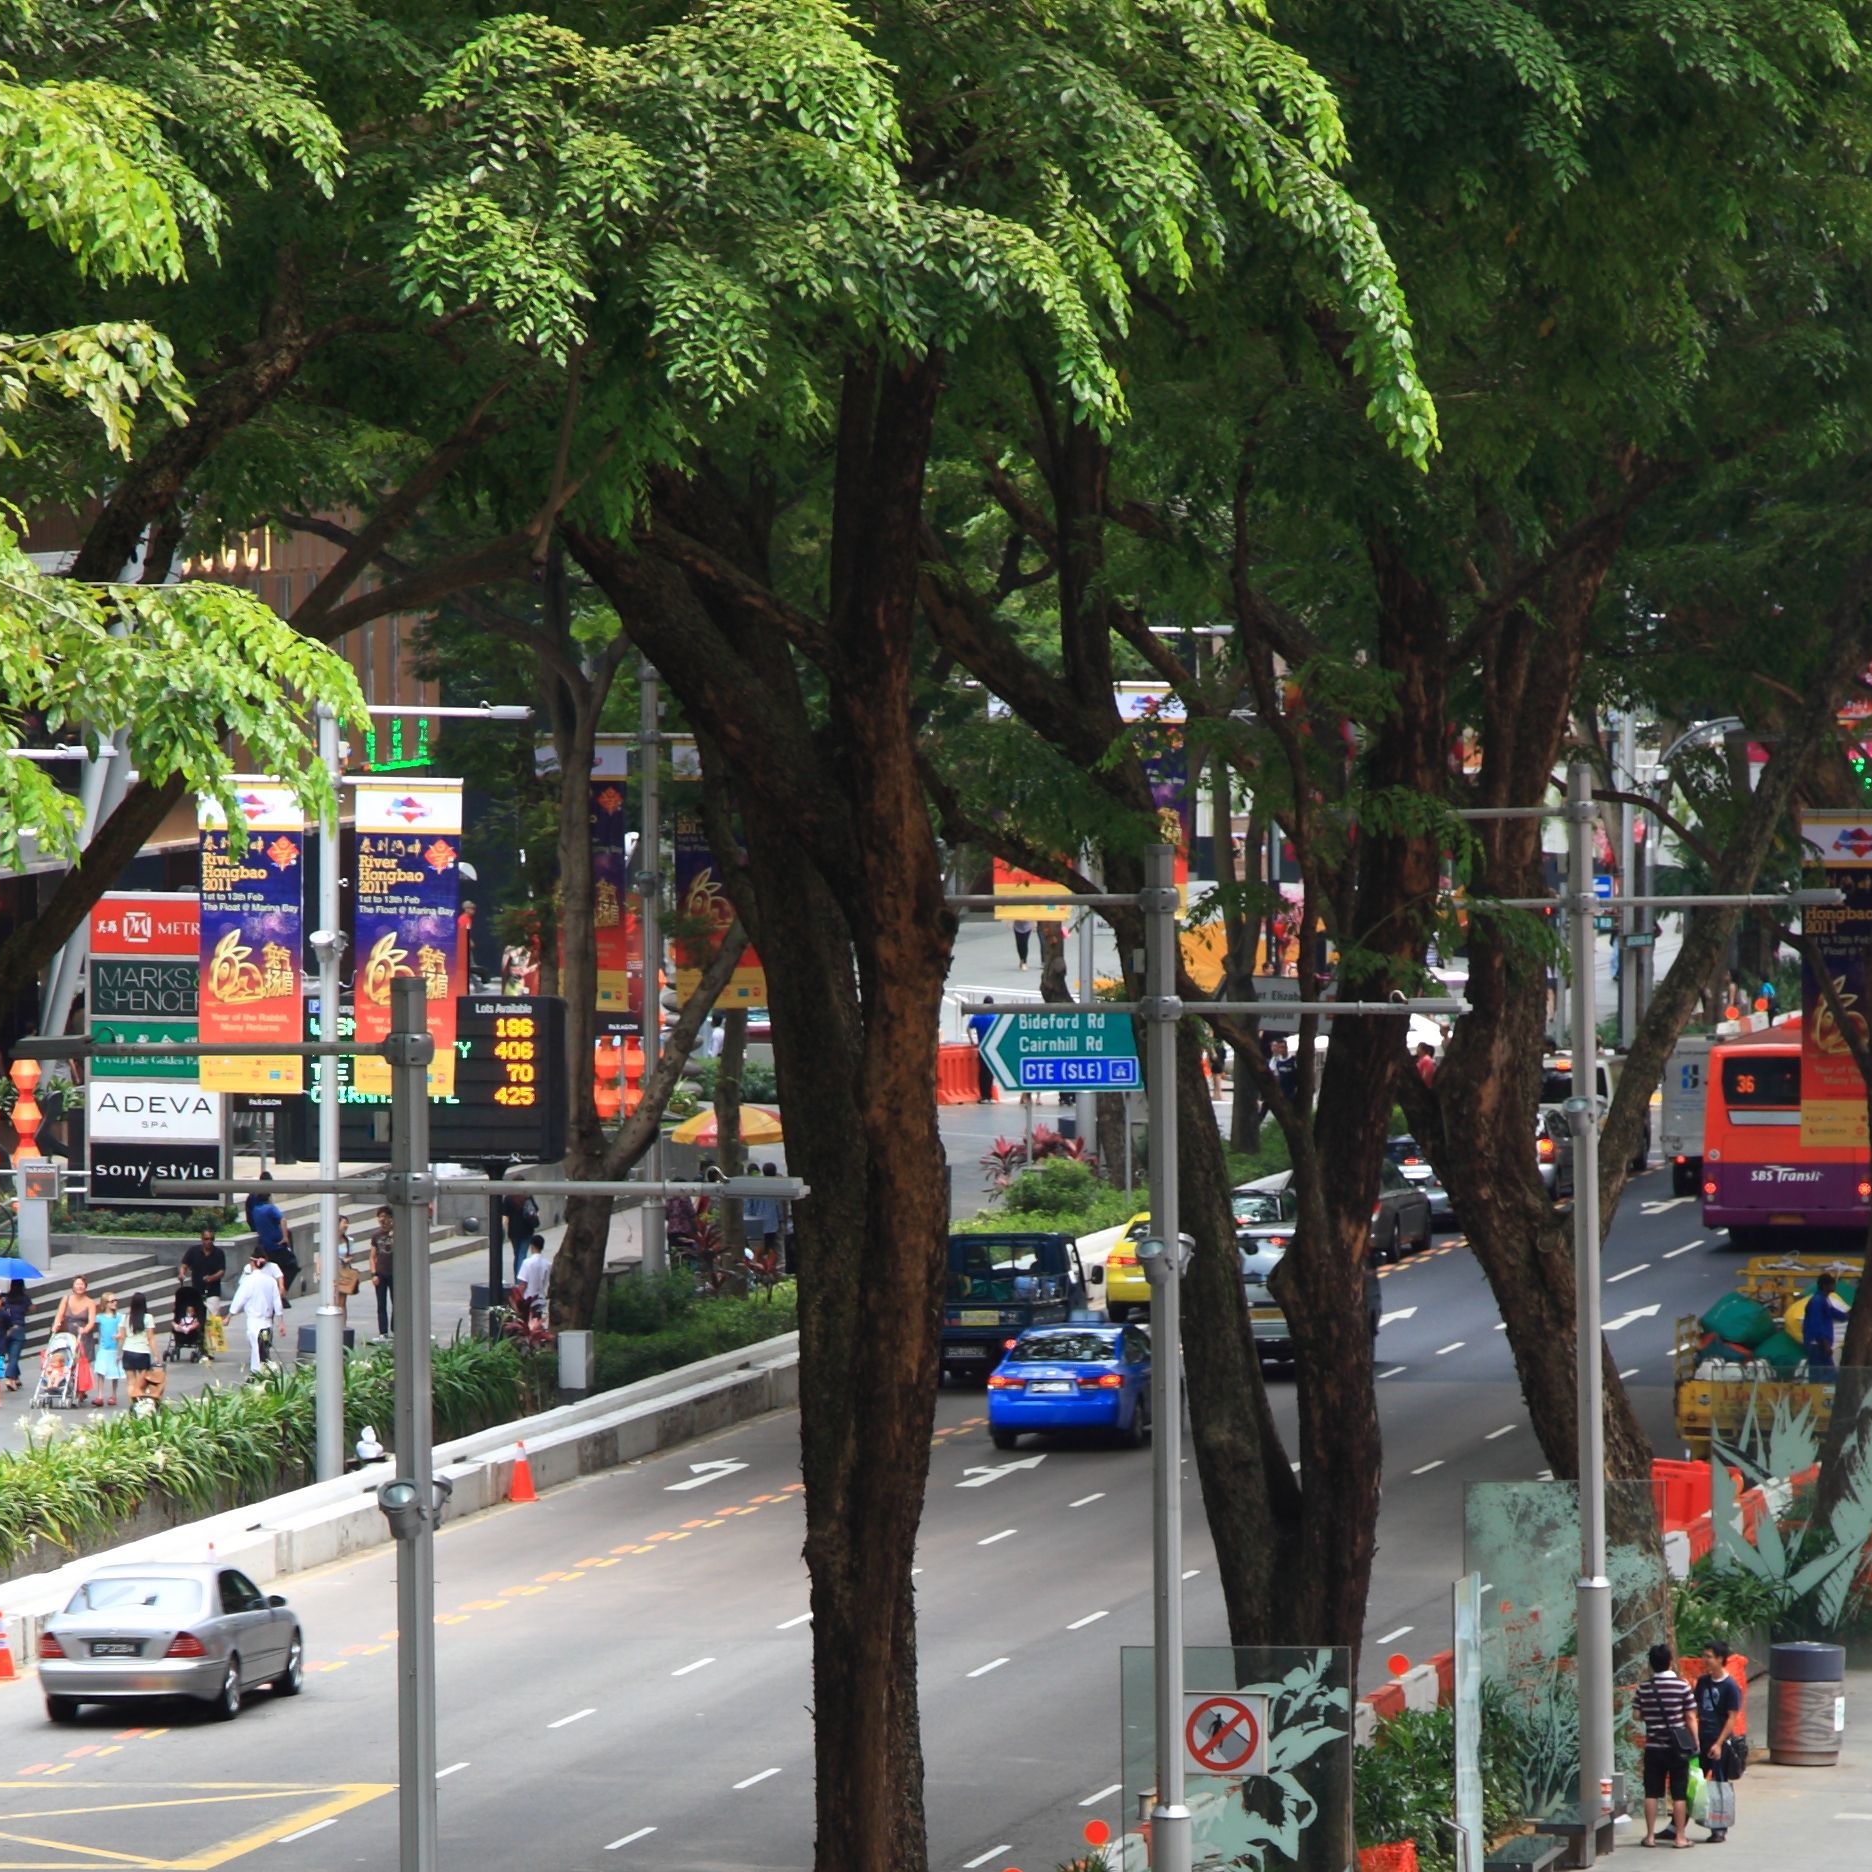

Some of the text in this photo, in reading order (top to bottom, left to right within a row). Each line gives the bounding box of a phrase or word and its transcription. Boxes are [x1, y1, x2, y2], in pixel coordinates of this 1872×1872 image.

[358, 854, 397, 869] River
[202, 866, 267, 883] Hongbao
[358, 868, 425, 885] Hongbao
[201, 878, 232, 892] 2011
[358, 880, 389, 895] 2011
[203, 892, 264, 902] 1st to 13th Feb
[359, 895, 420, 904] 1st to 13th Feb
[203, 902, 217, 911] The
[218, 902, 240, 912] Float
[251, 903, 279, 913] Marina
[280, 904, 299, 915] Bay
[359, 905, 373, 914] The
[375, 905, 398, 915] Float
[408, 906, 435, 915] Marina
[437, 907, 455, 917] Bay
[158, 921, 200, 935] METR
[1805, 919, 1836, 934] 2011
[98, 967, 191, 988] MARKS
[475, 1003, 532, 1014] Lots Available
[211, 1012, 231, 1022] Year
[232, 1012, 242, 1022] of
[243, 1012, 256, 1022] the
[366, 1015, 385, 1025] Year
[1019, 1013, 1106, 1030] Bideford Rd
[220, 1023, 280, 1034] Many Returns
[496, 1017, 535, 1038] 186
[1019, 1036, 1103, 1052] Cairnhill Rd
[506, 1063, 535, 1083] 70
[1025, 1062, 1103, 1081] CTE (SLE)
[1736, 1074, 1756, 1095] 36
[97, 1092, 213, 1115] ADEVA
[494, 1086, 535, 1106] 425
[140, 1120, 169, 1129] SPA
[95, 1162, 215, 1184] sony style
[1751, 1166, 1825, 1183] SBS Transit
